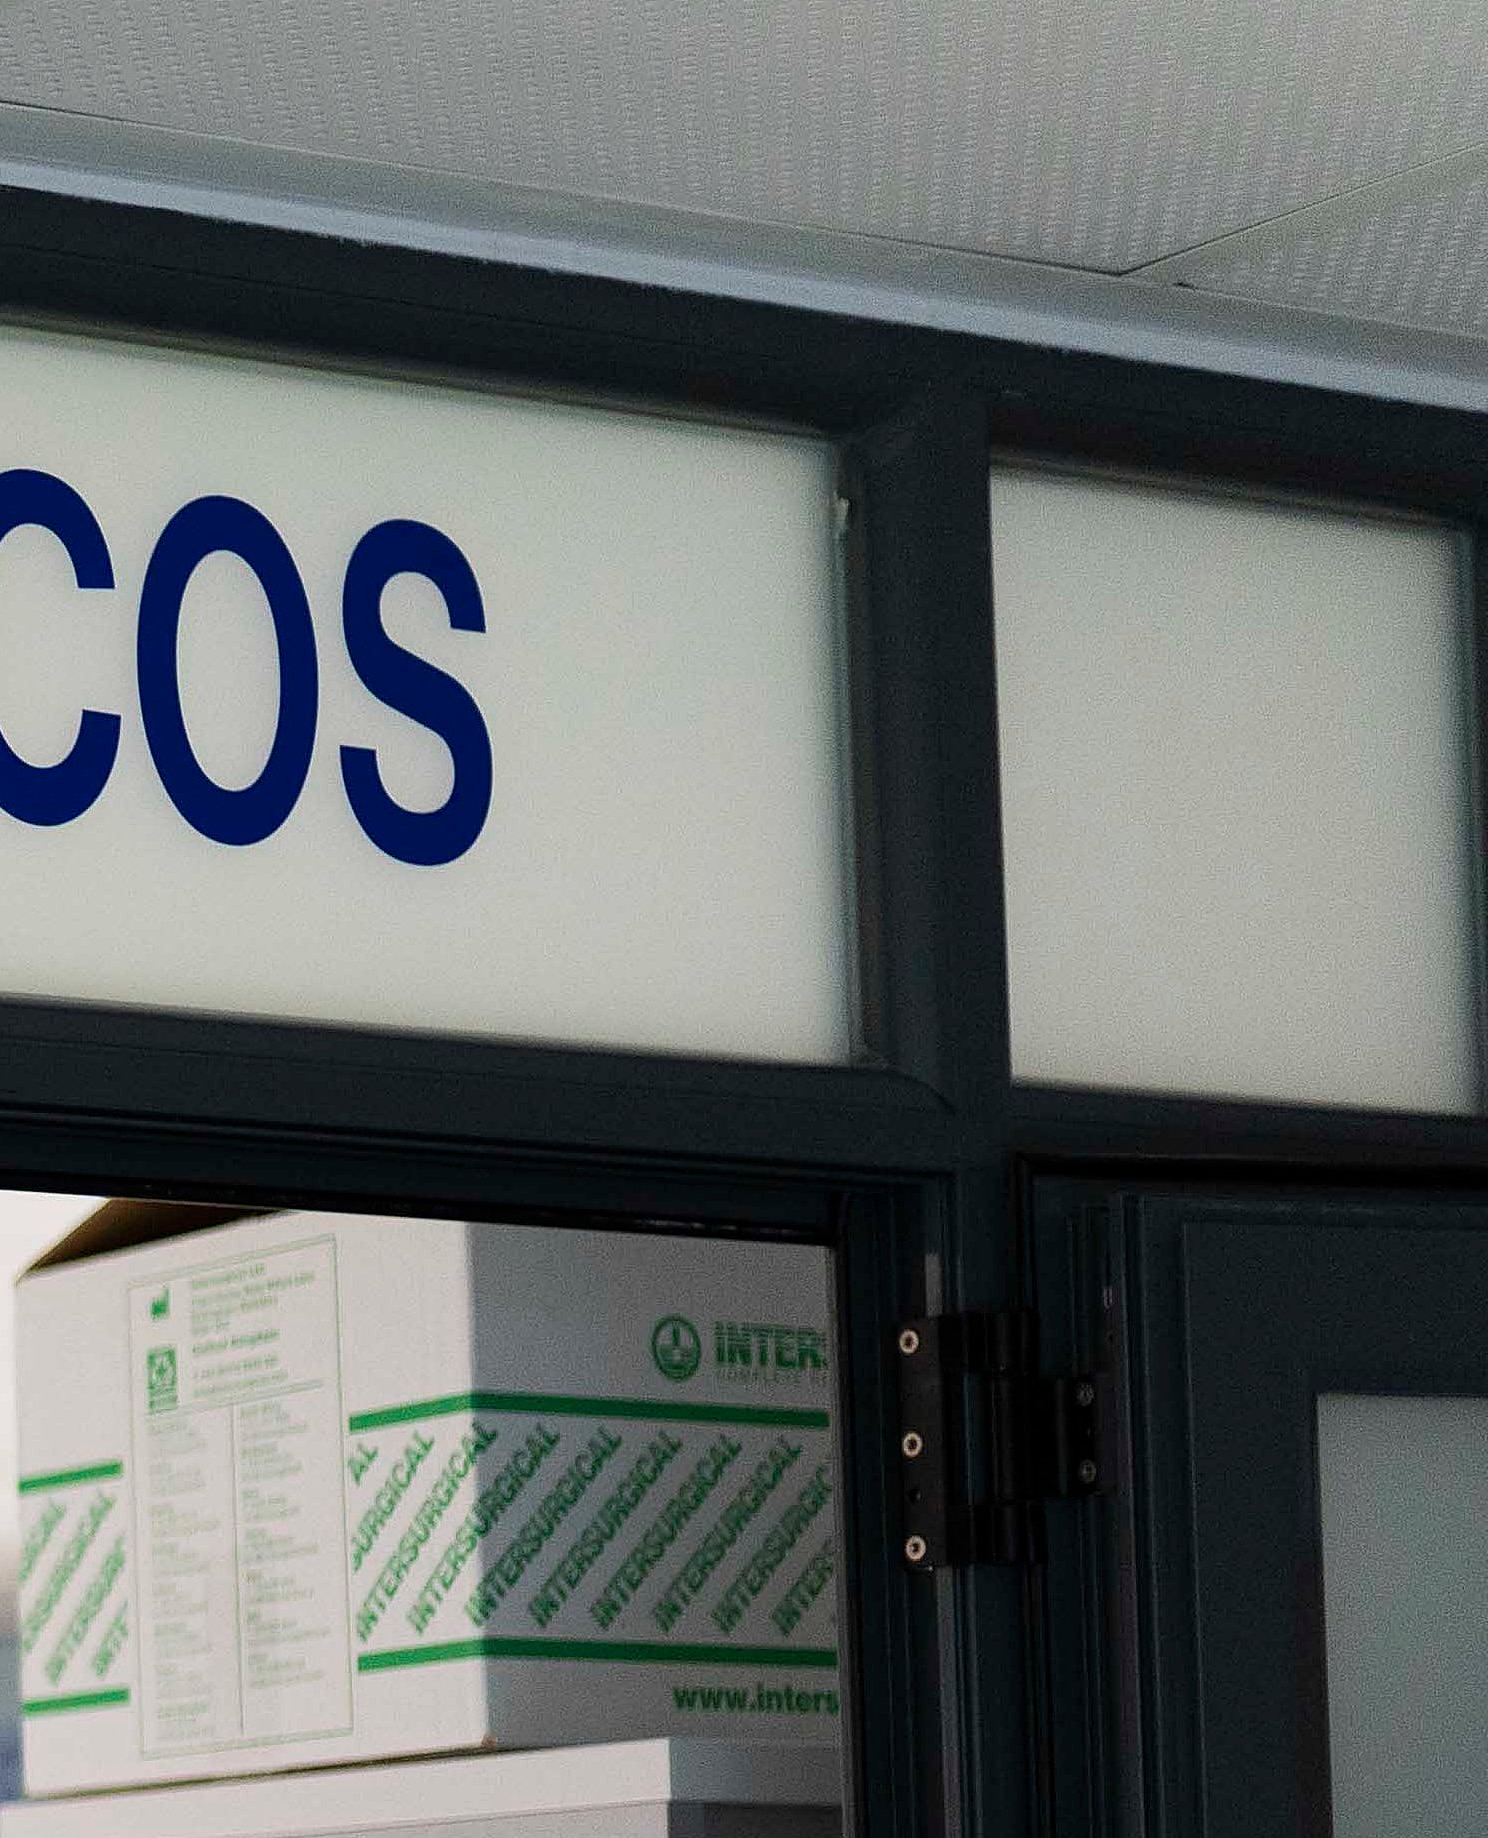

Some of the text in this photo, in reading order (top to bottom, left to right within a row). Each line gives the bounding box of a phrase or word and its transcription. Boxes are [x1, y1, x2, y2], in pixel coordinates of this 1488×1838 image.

[714, 1321, 828, 1369] INTER
[357, 1419, 497, 1642] INTERSURGICAL
[406, 1422, 560, 1636] INTERSURGICAL
[464, 1424, 622, 1628] INTERSURGICAL
[529, 1428, 684, 1629] INTERSURGICAL
[590, 1433, 743, 1631] INTERSURGICAL
[651, 1434, 803, 1634] INTERSURGICAL
